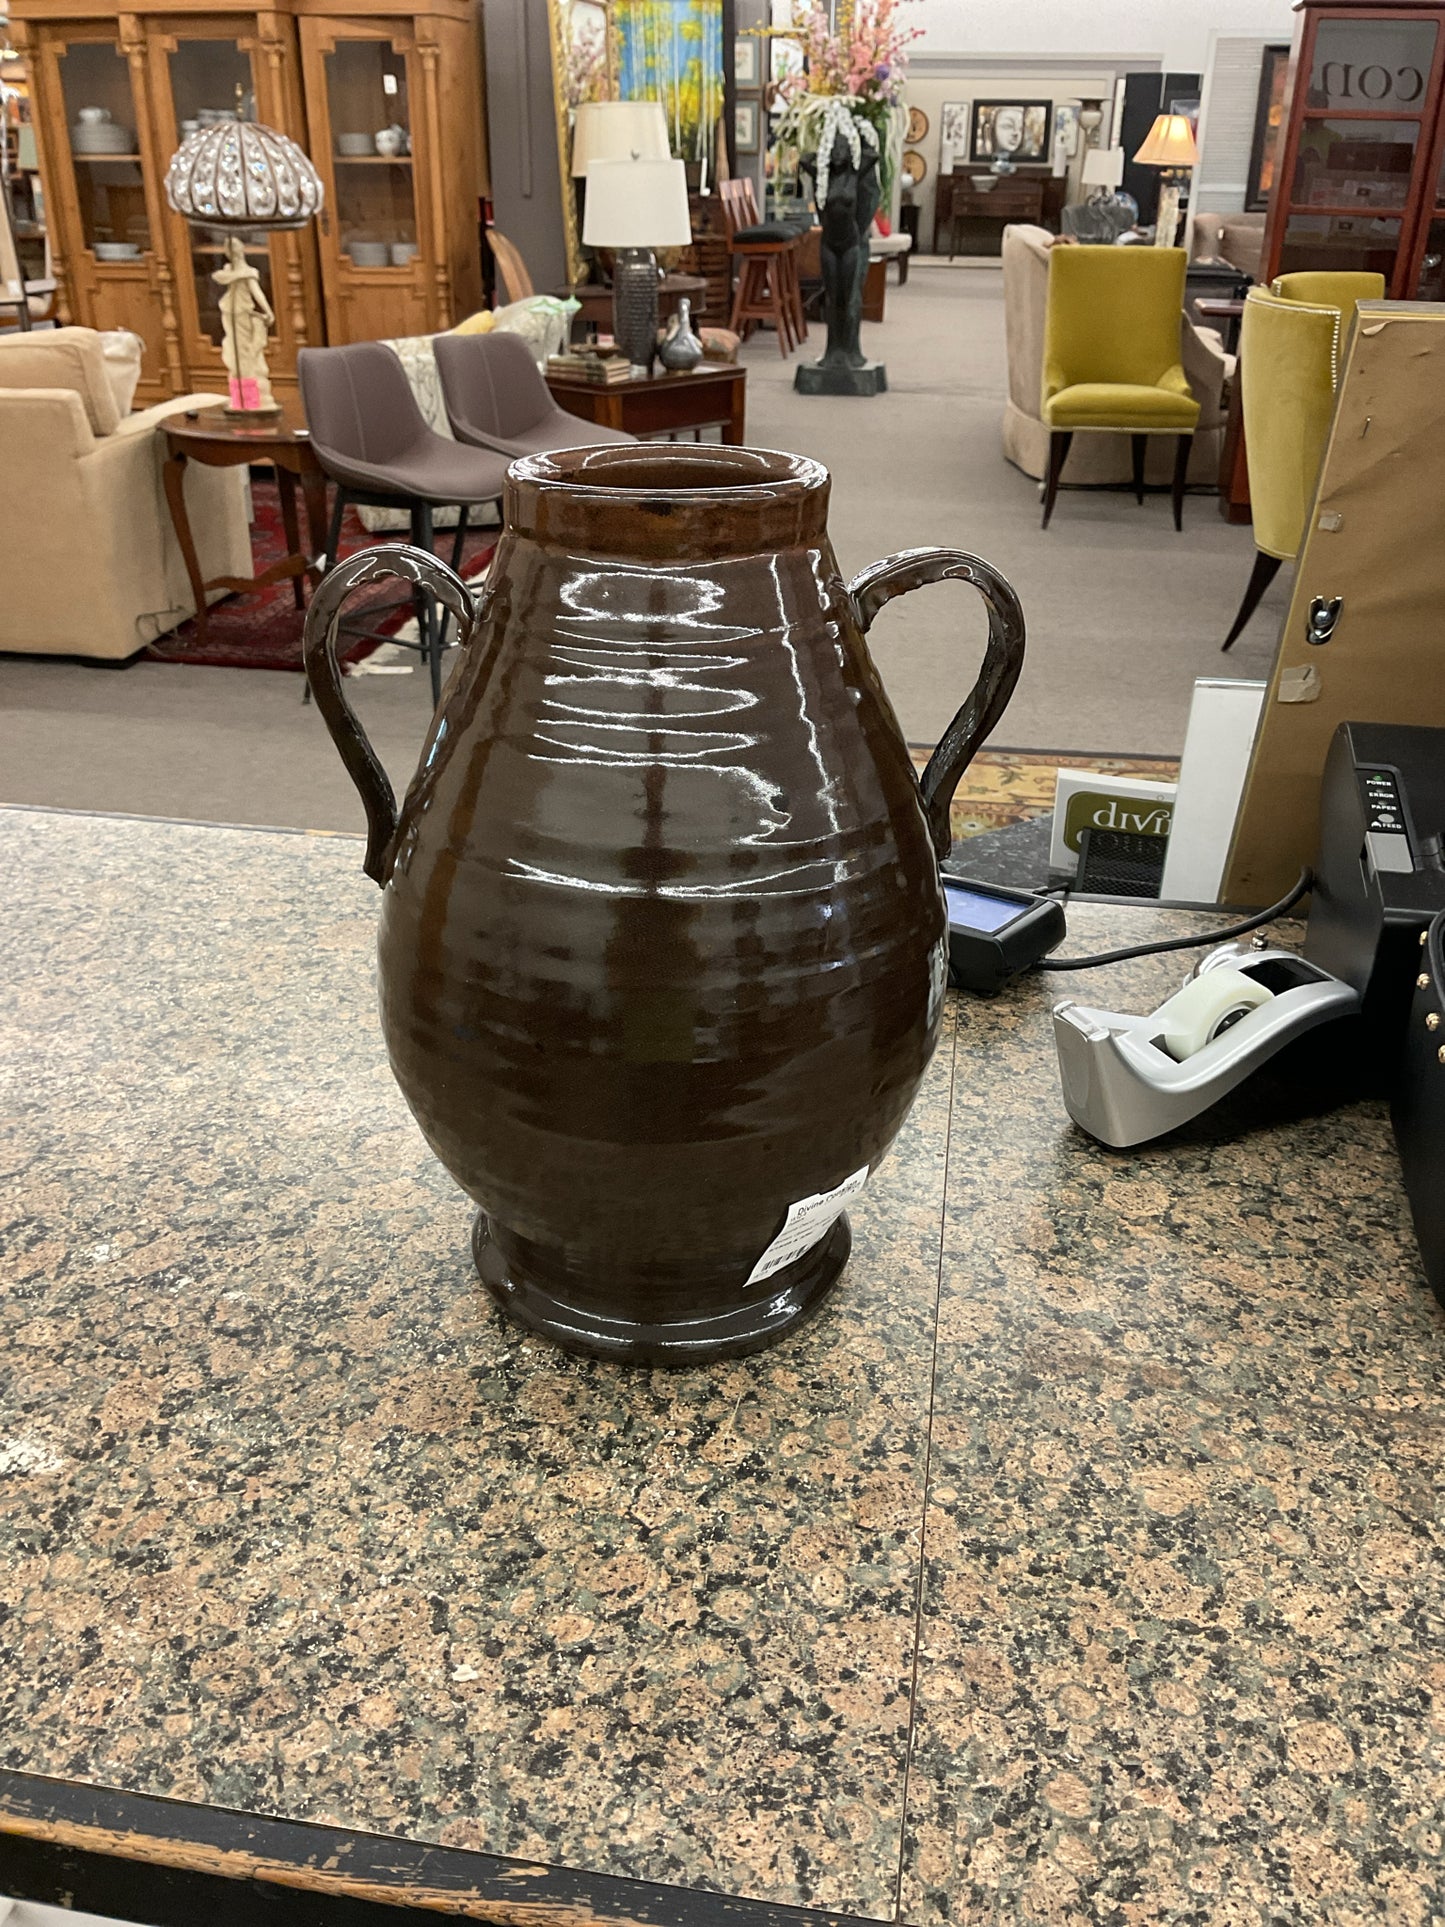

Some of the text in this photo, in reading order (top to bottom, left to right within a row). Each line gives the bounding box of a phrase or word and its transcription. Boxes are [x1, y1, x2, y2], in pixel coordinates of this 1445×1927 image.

[1366, 779, 1392, 787] POWER
[1368, 791, 1395, 799] ERROR
[1382, 822, 1402, 830] FEED
